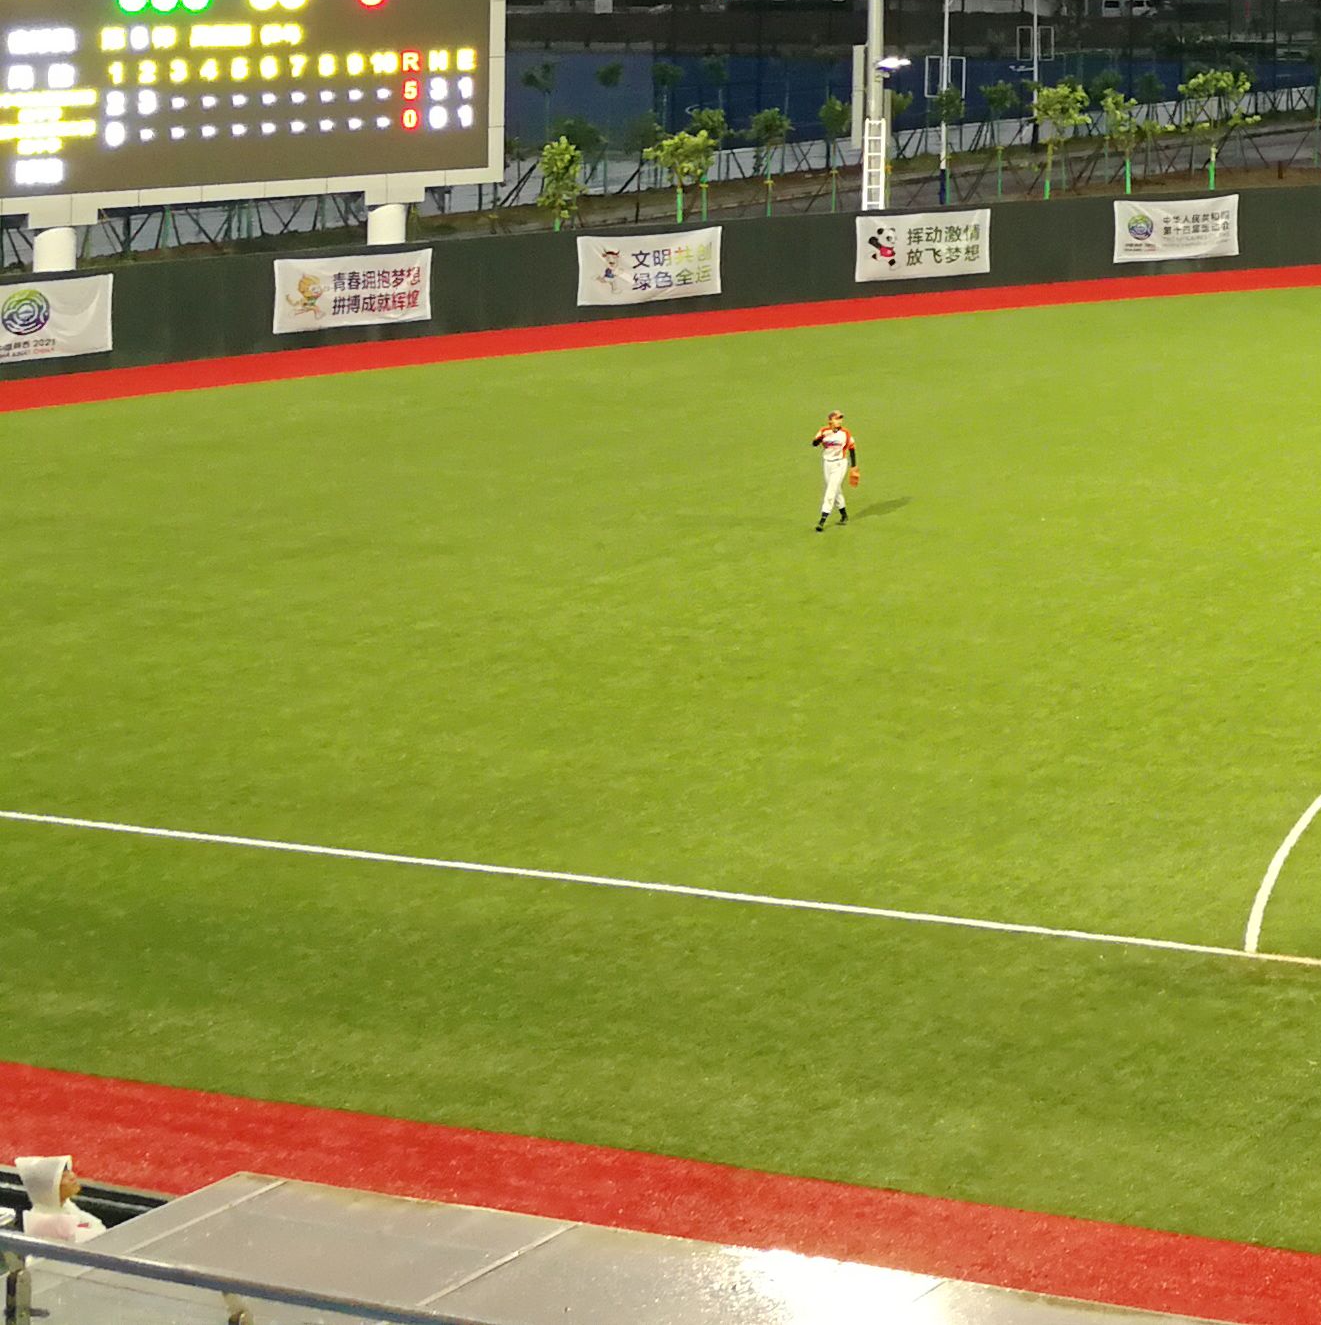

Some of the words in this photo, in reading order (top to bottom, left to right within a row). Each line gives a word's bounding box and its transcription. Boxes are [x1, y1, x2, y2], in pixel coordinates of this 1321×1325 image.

[108, 62, 124, 85] 1
[138, 60, 157, 83] 2
[169, 58, 188, 82] 3
[199, 58, 219, 81] 4
[289, 54, 308, 78] 7
[402, 50, 420, 72] R
[428, 49, 449, 71] H
[457, 48, 476, 71] E
[403, 80, 418, 100] 5
[457, 76, 474, 100] 1
[402, 109, 418, 130] 0
[457, 104, 474, 127] 1
[907, 224, 980, 245] 挥动激情
[632, 242, 713, 269] 文明共创
[906, 244, 980, 266] 放飞梦想
[333, 266, 421, 292] 青春拥抱梦想
[632, 264, 712, 291] 绿色全运
[332, 289, 420, 316] 拼搏成就辉煌
